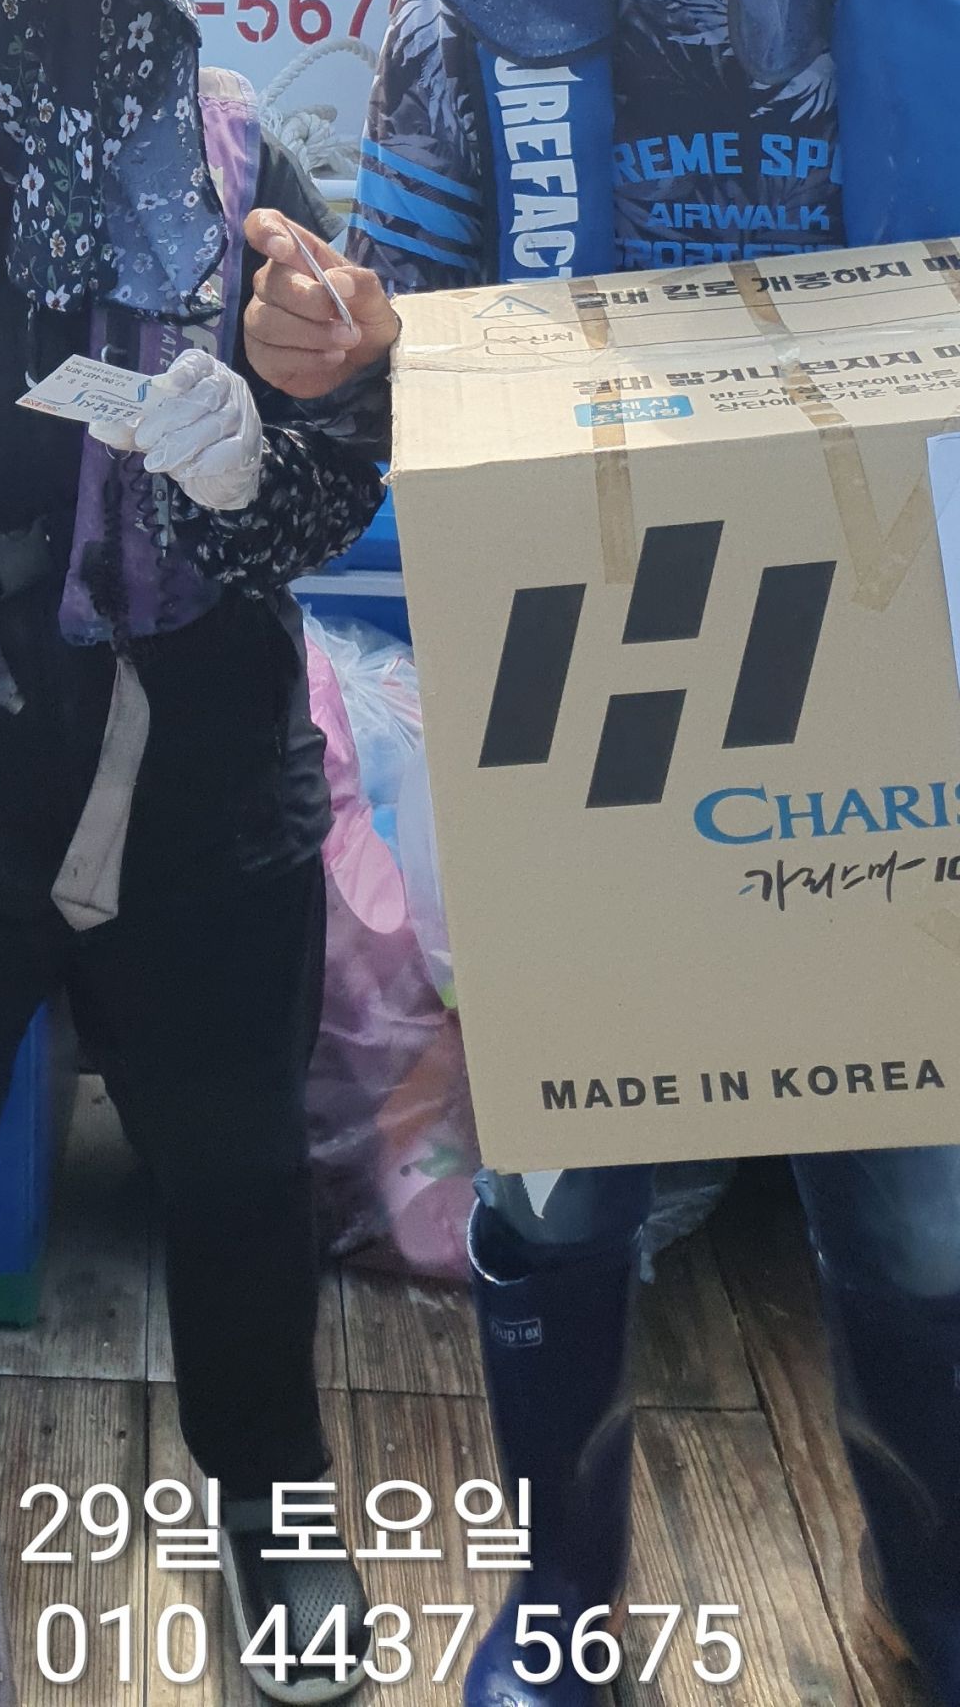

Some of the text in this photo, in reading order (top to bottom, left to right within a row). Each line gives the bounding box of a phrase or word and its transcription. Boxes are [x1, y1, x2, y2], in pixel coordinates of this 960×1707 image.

[494, 55, 584, 282] UREFAC
[647, 202, 830, 231] AIRWALK
[751, 260, 913, 293] 개봉하지
[540, 1059, 947, 1111] MADE IN KOREA
